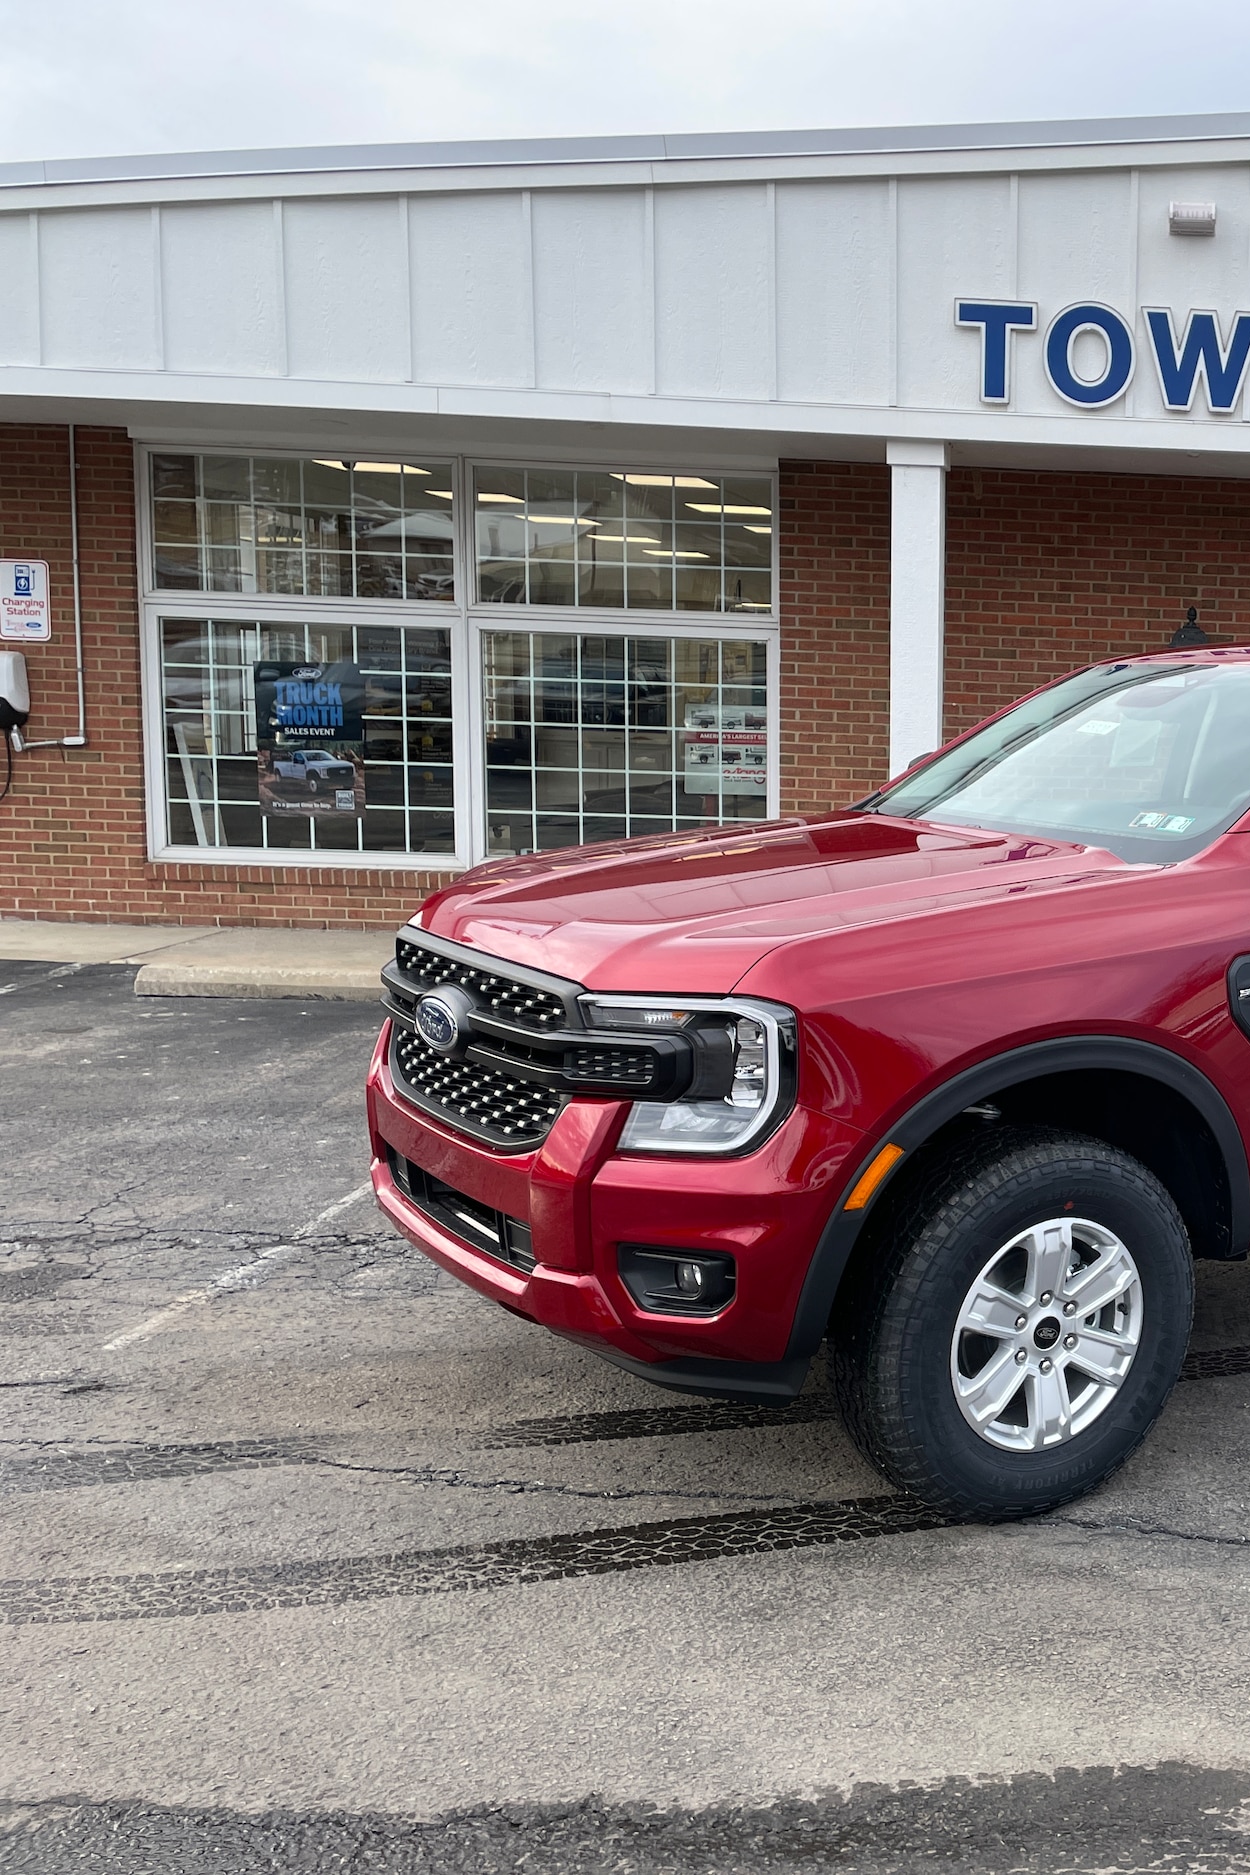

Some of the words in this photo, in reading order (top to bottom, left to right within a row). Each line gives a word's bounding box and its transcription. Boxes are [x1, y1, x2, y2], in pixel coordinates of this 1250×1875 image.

[2, 597, 45, 609] Charging
[6, 607, 41, 616] Station
[273, 681, 343, 705] TRUCK
[276, 704, 344, 726] MONTH
[284, 727, 309, 736] SALES
[310, 728, 336, 737] EVENT
[1013, 1458, 1096, 1490] TERRITORY
